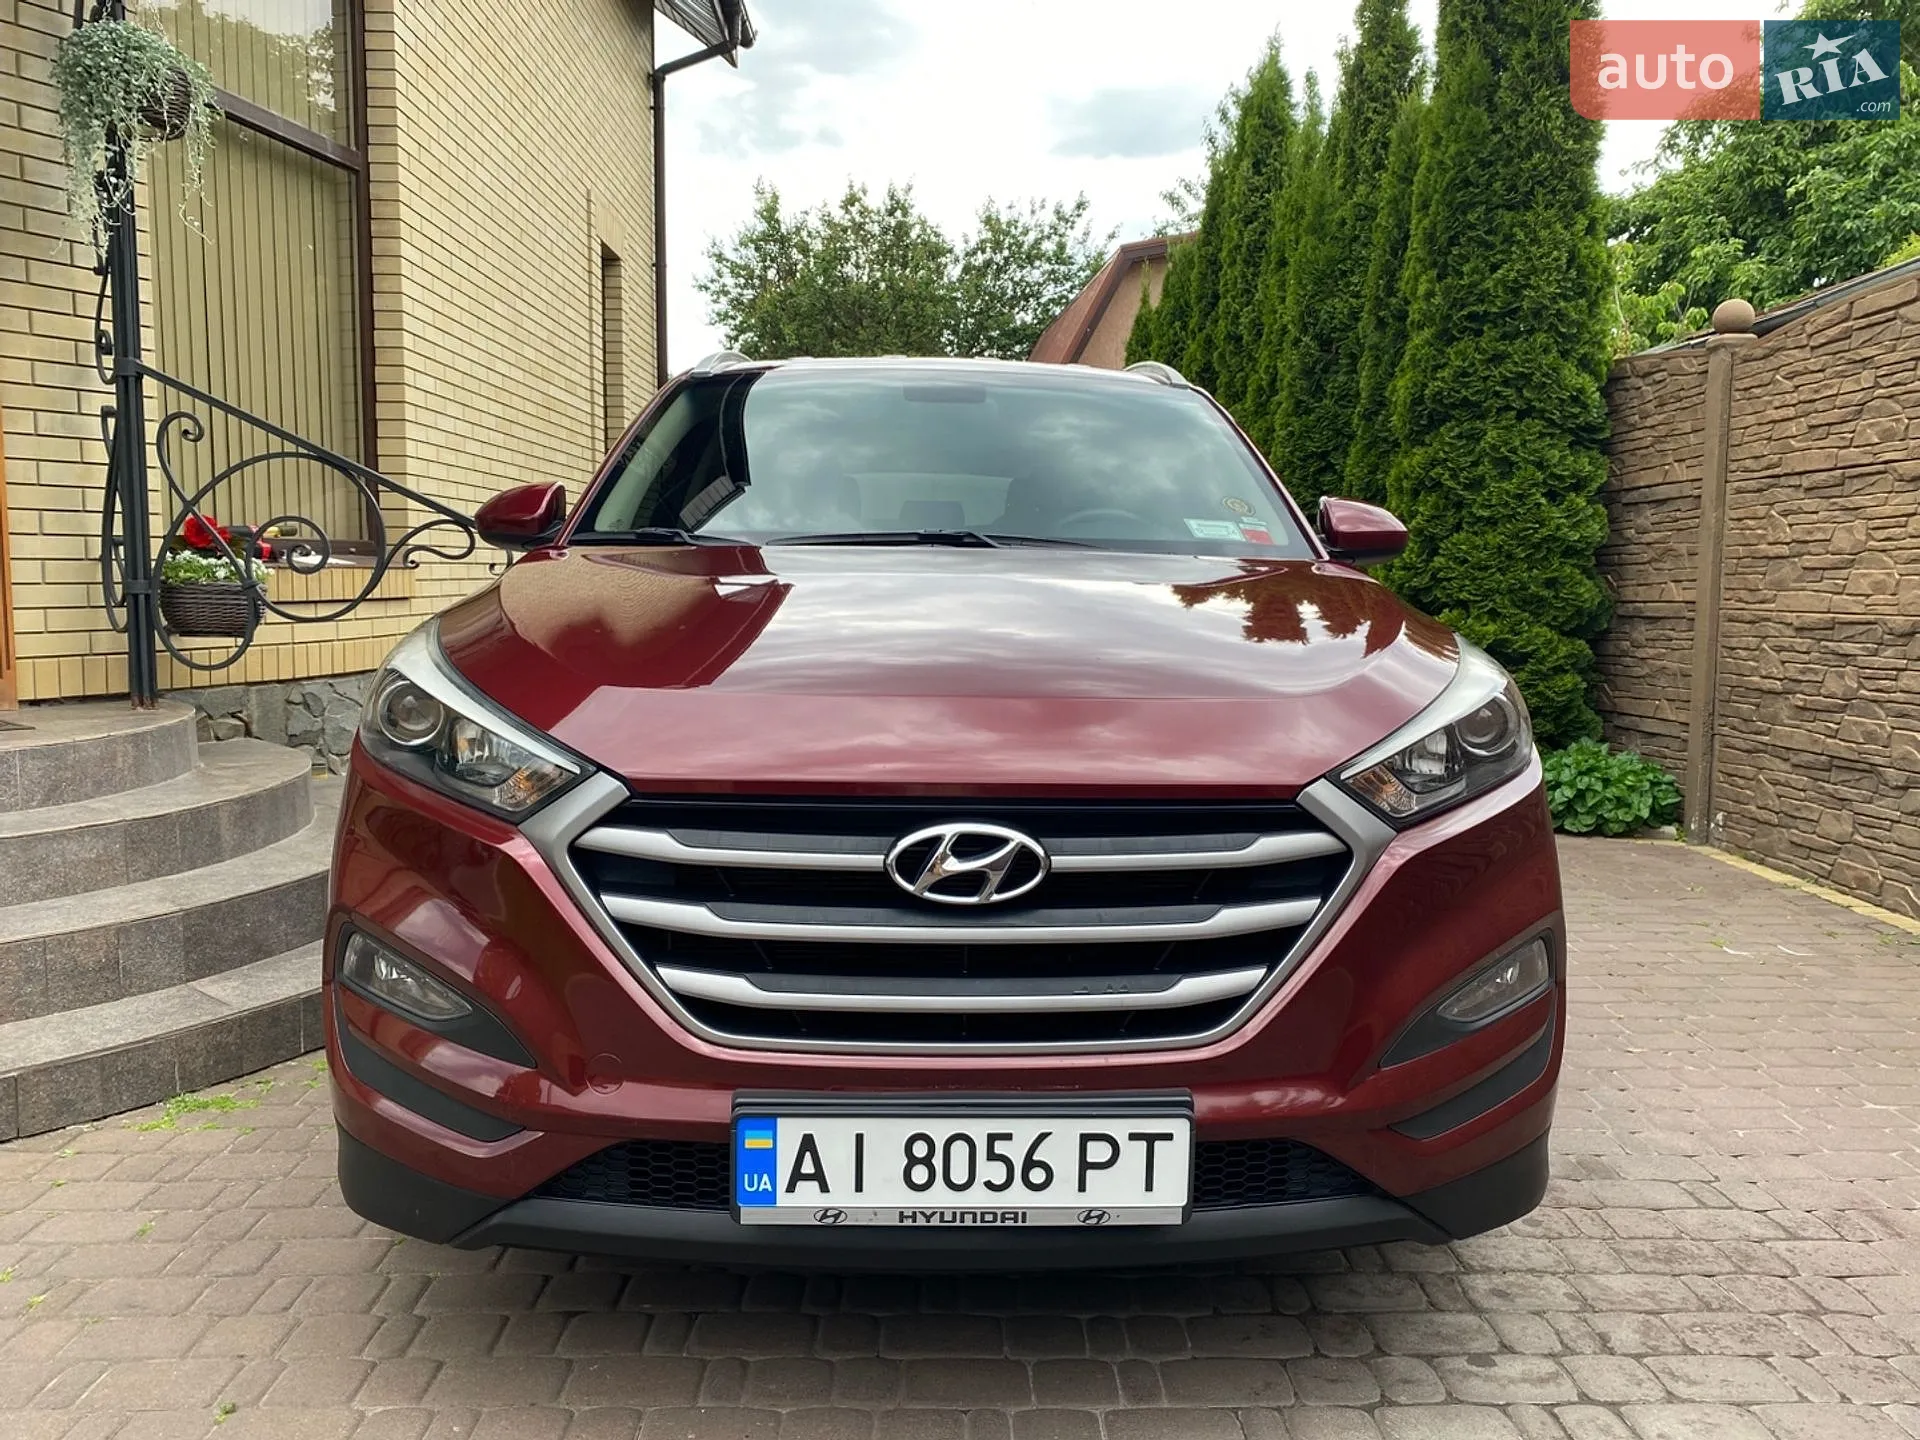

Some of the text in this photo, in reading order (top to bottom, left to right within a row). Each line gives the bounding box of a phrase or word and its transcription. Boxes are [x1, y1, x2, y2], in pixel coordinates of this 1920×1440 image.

[785, 1132, 1174, 1193] AI 8056 PT
[744, 1174, 772, 1192] UA
[899, 1211, 1027, 1224] HYUNDAI
